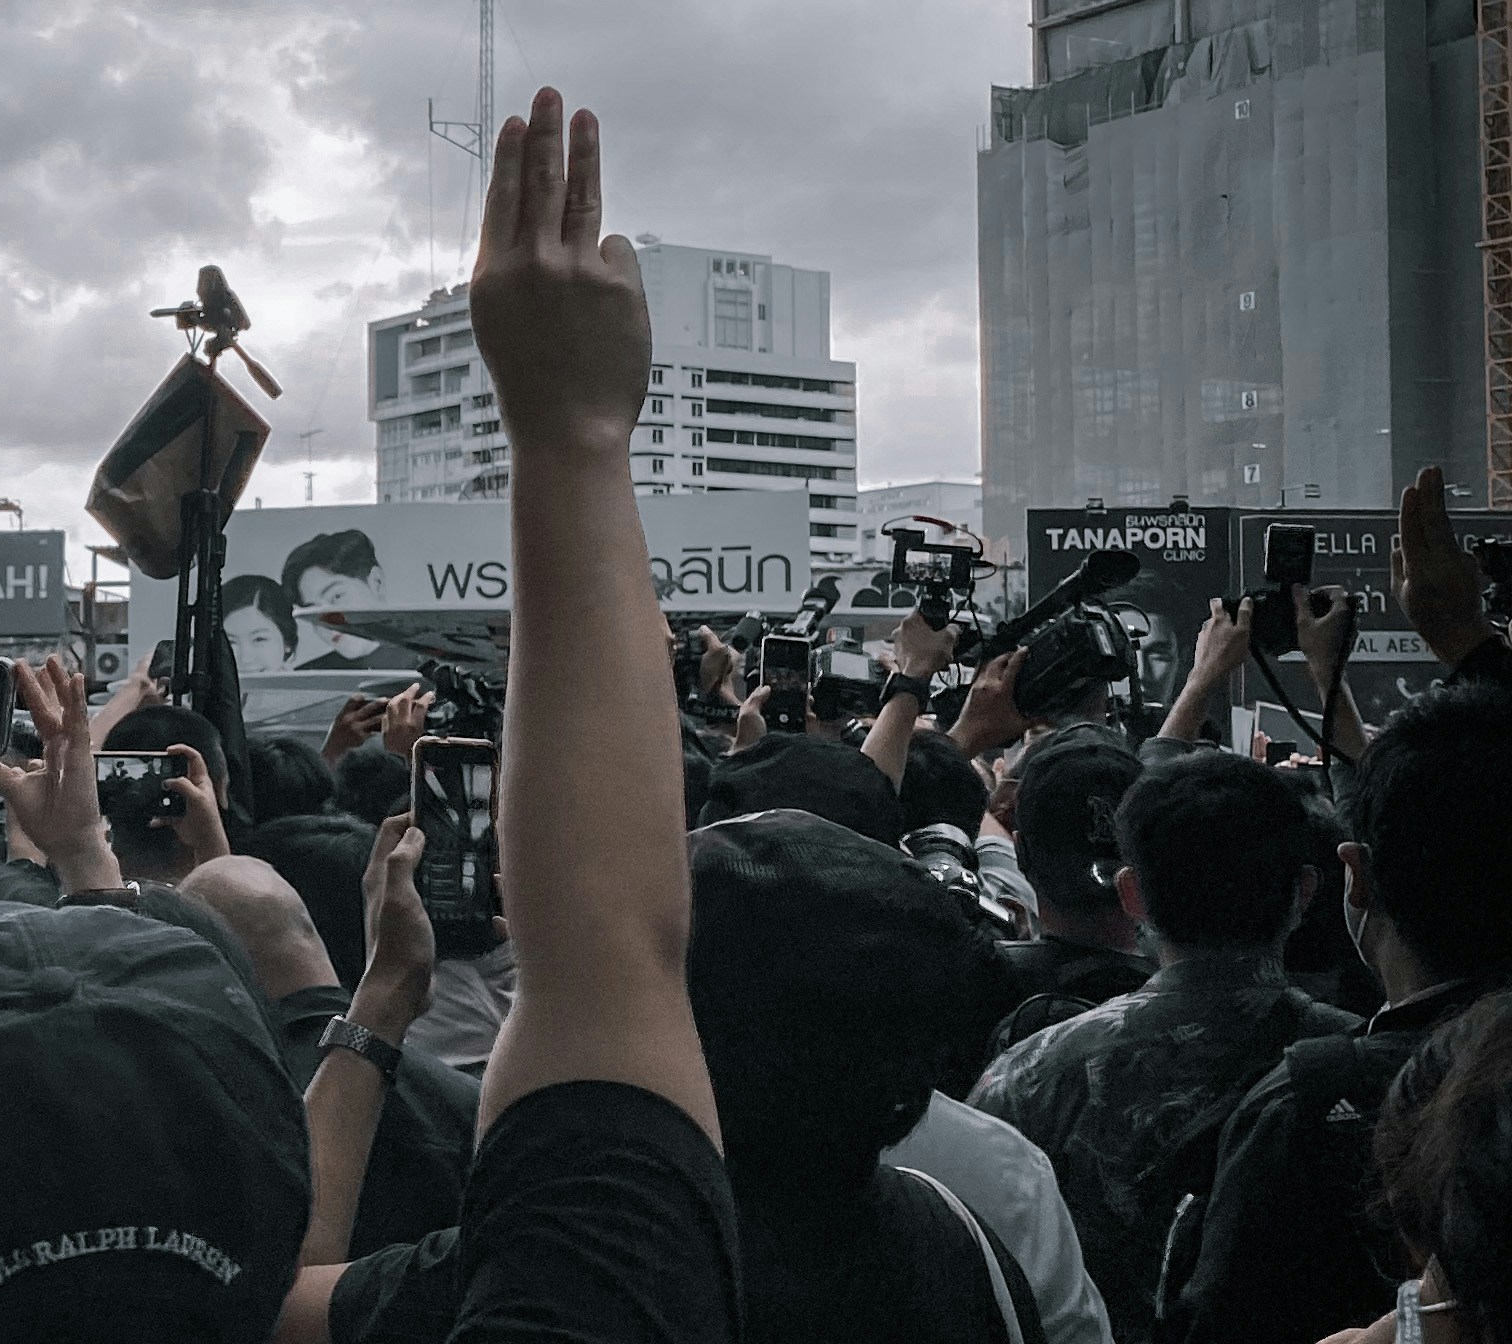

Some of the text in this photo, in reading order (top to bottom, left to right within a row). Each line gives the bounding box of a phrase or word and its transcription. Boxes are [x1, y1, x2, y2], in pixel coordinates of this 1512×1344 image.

[1045, 527, 1207, 551] TANAPORN
[1303, 532, 1377, 555] ELLA
[1162, 550, 1207, 562] CLINIC
[30, 1226, 139, 1267] RALPH
